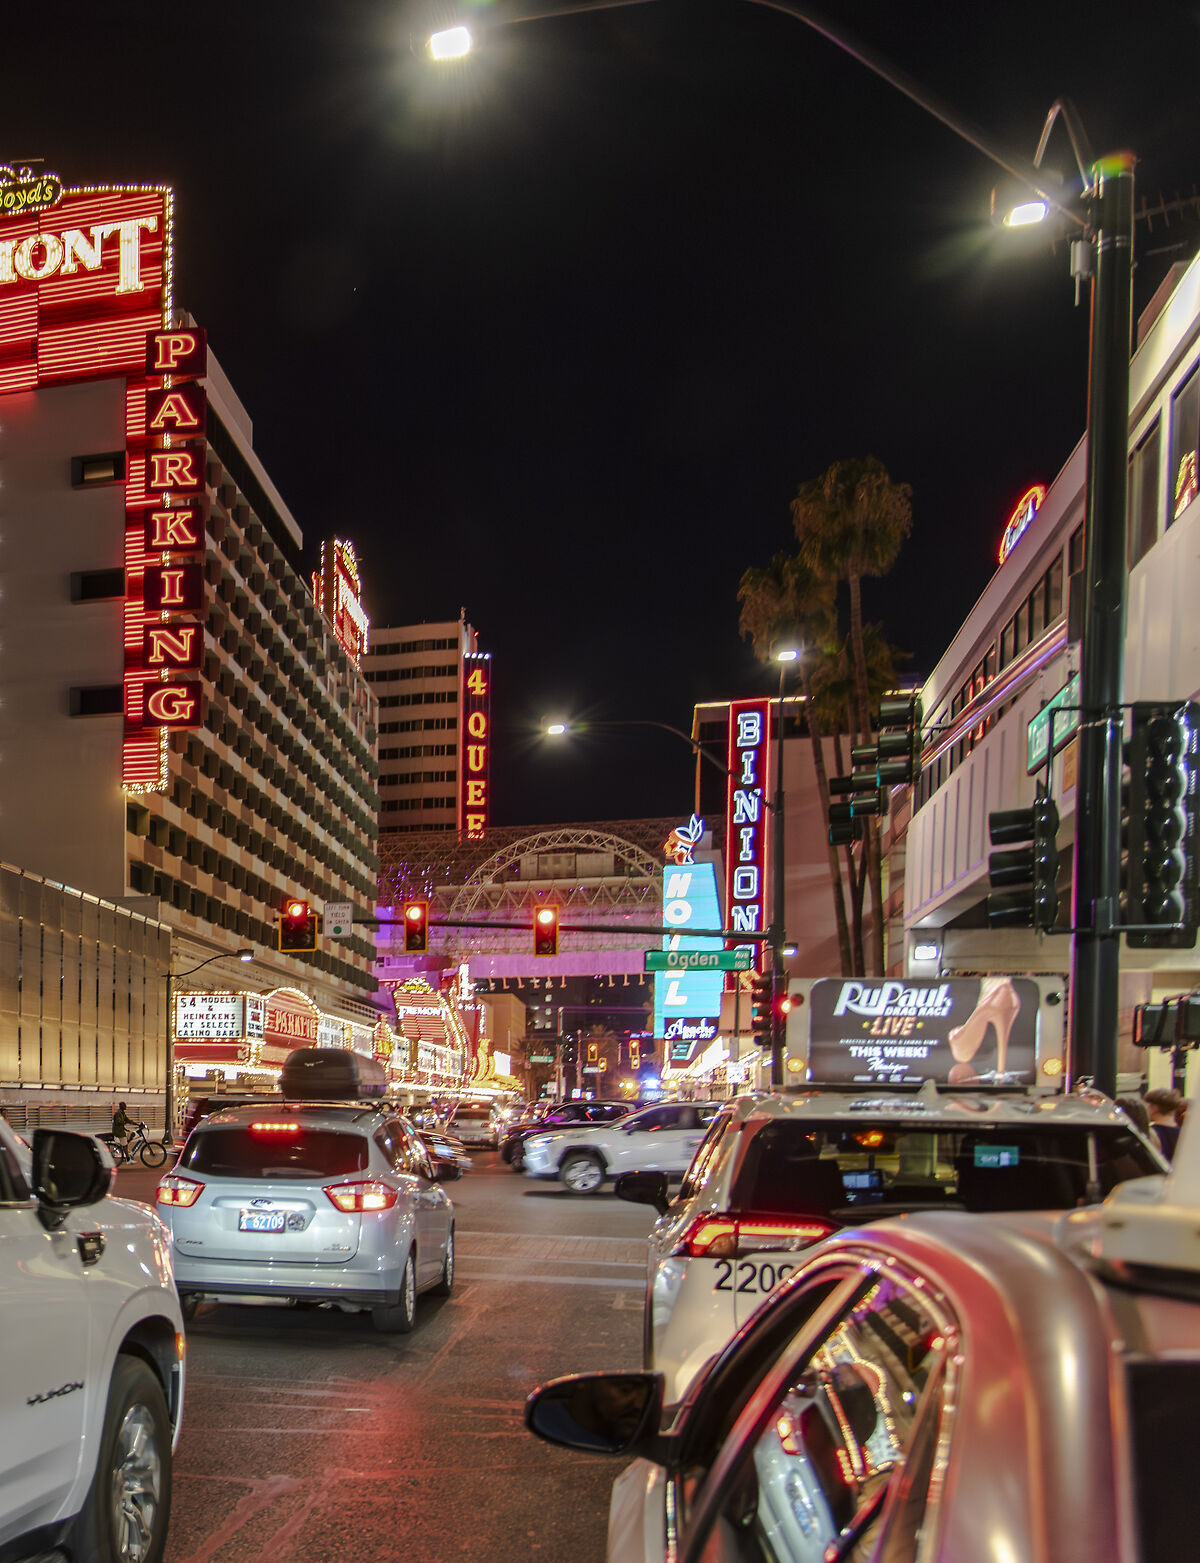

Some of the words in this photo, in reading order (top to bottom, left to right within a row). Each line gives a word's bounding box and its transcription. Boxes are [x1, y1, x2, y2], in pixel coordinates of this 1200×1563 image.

[148, 333, 198, 722] PARKING
[467, 669, 488, 697] 4
[667, 951, 719, 970] Ogden
[734, 951, 749, 960] Ave
[200, 996, 237, 1004] MODELO
[177, 1029, 211, 1037] CASINO
[215, 1029, 241, 1037] BARS
[183, 1021, 194, 1029] AT
[200, 1021, 236, 1029] SELECT
[869, 1016, 918, 1036] LIVE
[848, 1045, 882, 1058] THIS
[883, 1046, 929, 1059] WEEK!
[26, 1380, 85, 1406] YUKON
